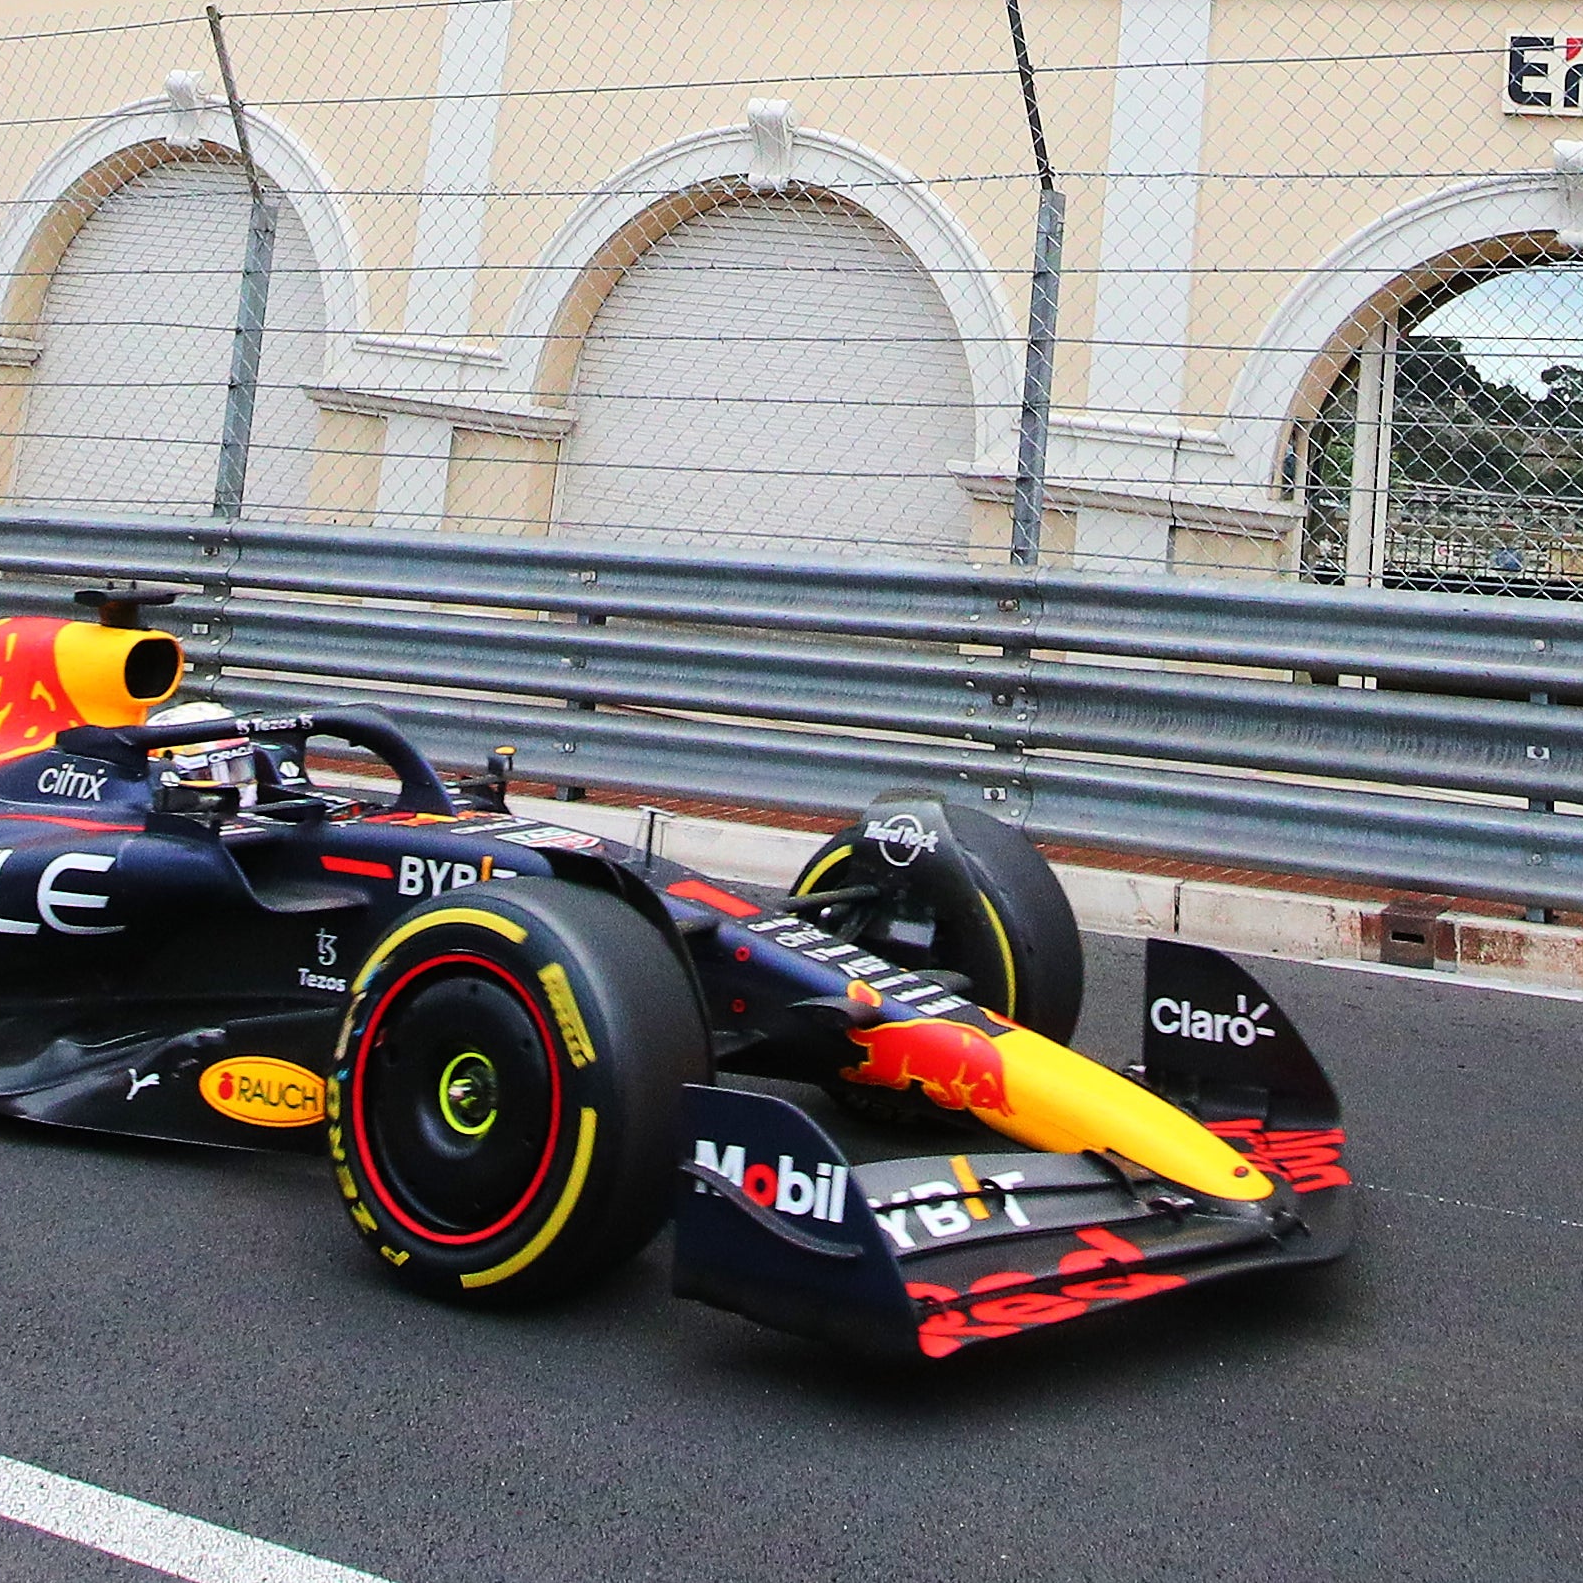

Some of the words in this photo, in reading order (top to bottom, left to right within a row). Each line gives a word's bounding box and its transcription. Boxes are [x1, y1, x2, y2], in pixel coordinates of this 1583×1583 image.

[38, 764, 108, 801] citrix
[298, 968, 347, 992] Tezos
[1150, 997, 1258, 1048] Claro
[237, 1075, 318, 1112] RAUCH
[694, 1139, 848, 1223] Mobil
